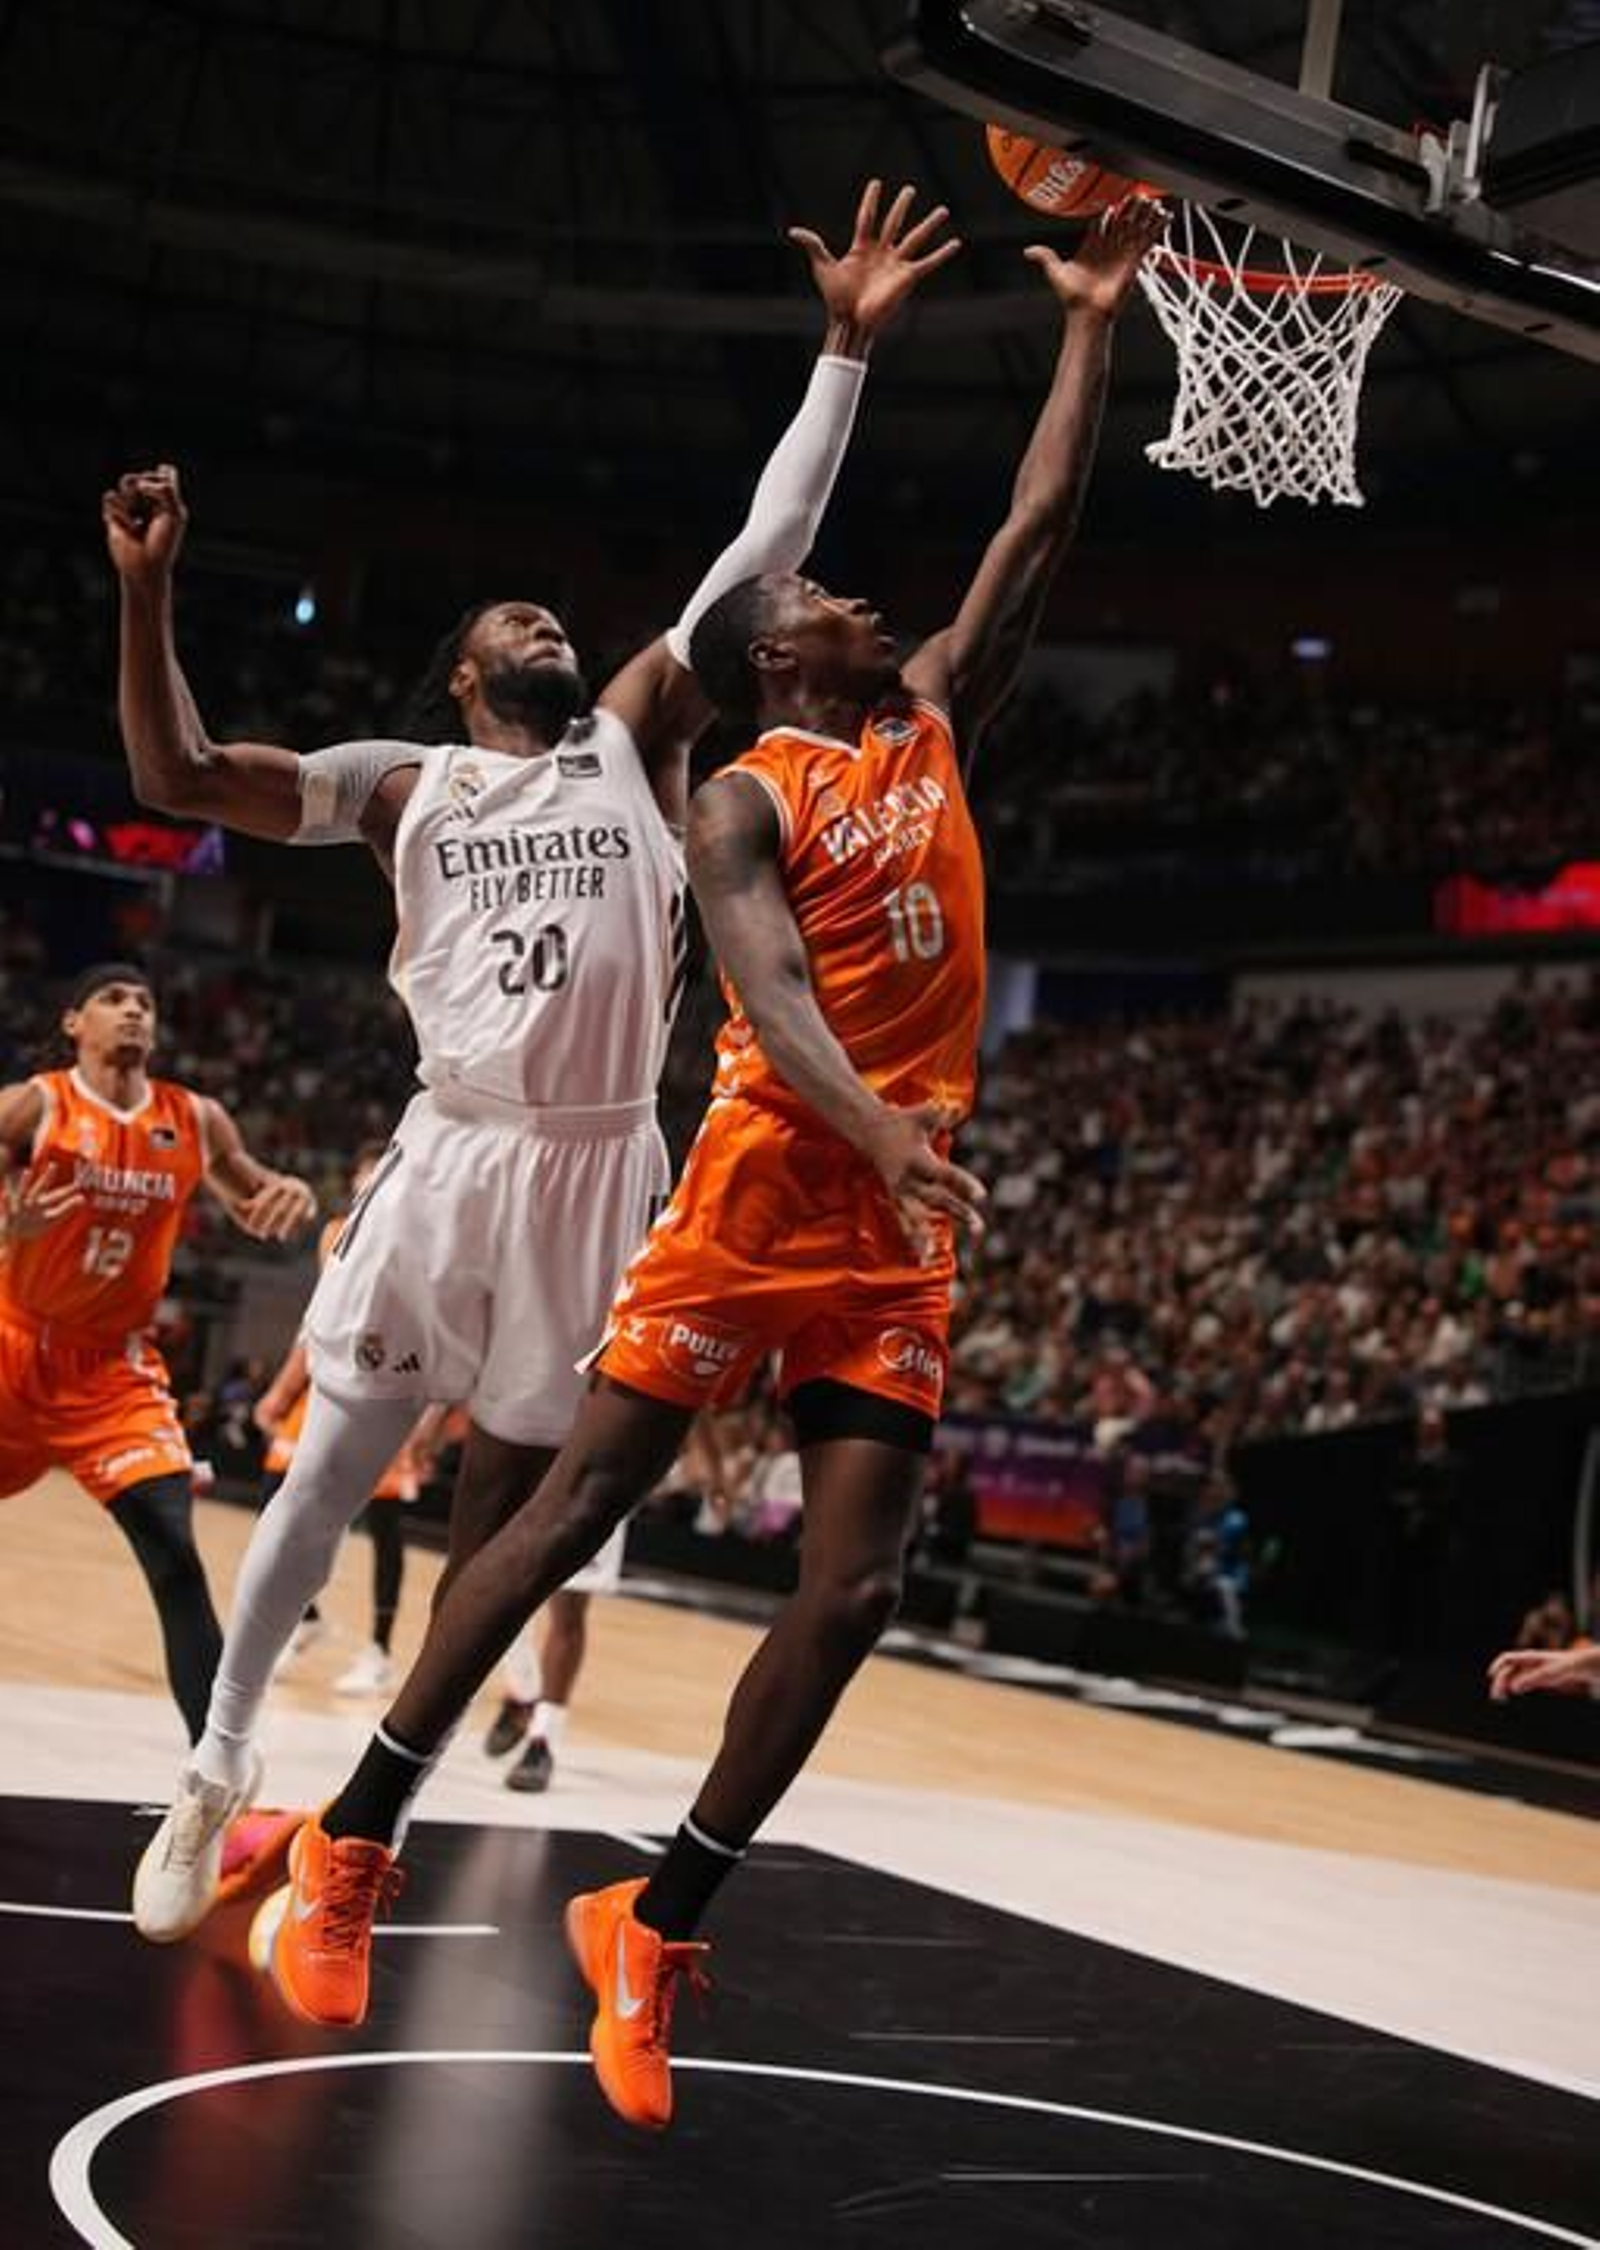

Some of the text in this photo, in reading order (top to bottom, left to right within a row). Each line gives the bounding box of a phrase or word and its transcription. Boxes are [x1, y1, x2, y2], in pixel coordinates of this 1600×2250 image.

[435, 825, 631, 880] Emirates
[469, 865, 605, 912] FLY BETTER
[882, 881, 944, 962] 10
[490, 923, 567, 997] 20
[82, 1227, 134, 1279] 12
